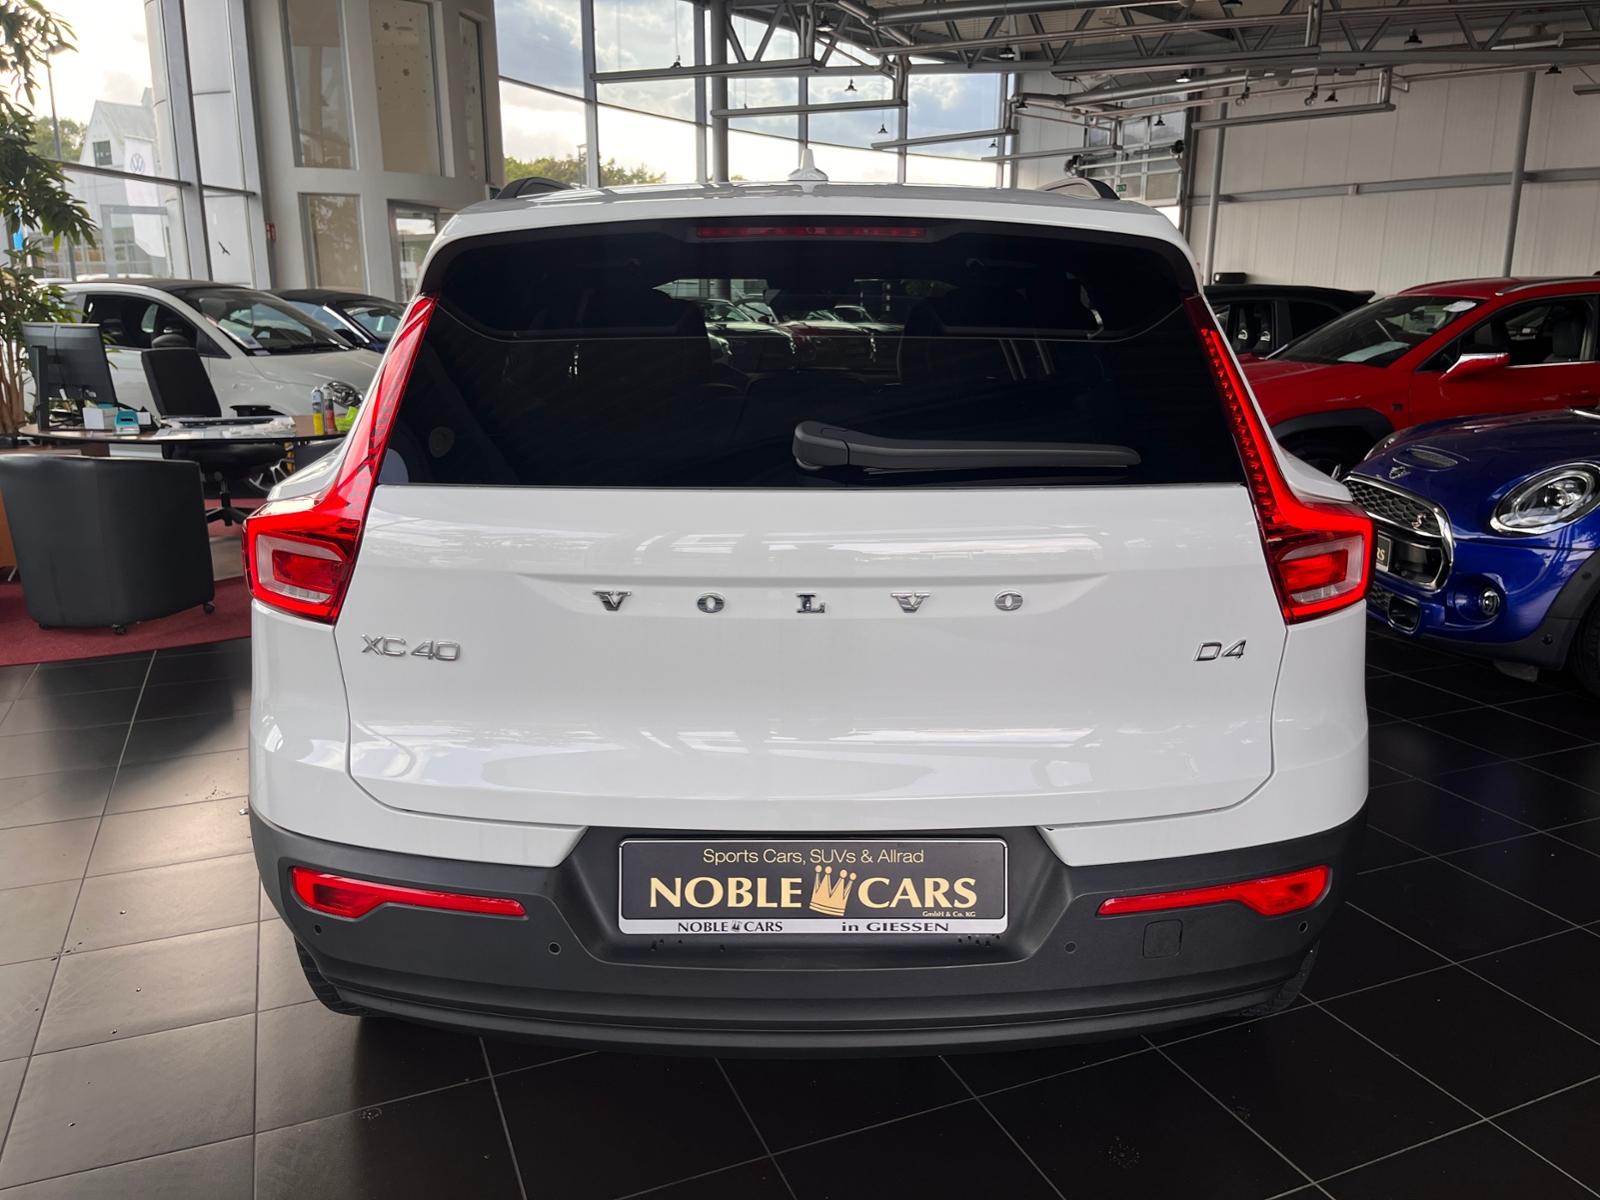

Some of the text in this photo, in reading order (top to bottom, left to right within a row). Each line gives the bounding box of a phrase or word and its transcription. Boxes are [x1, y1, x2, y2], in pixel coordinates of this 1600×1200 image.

[593, 590, 1024, 615] VOLVO
[1193, 639, 1247, 662] D4
[703, 848, 924, 866] Sports Cars, SUVs & Allrad
[650, 876, 978, 909] NOBLE CARS
[678, 921, 949, 932] NOBLE CARS in GIESSEN
